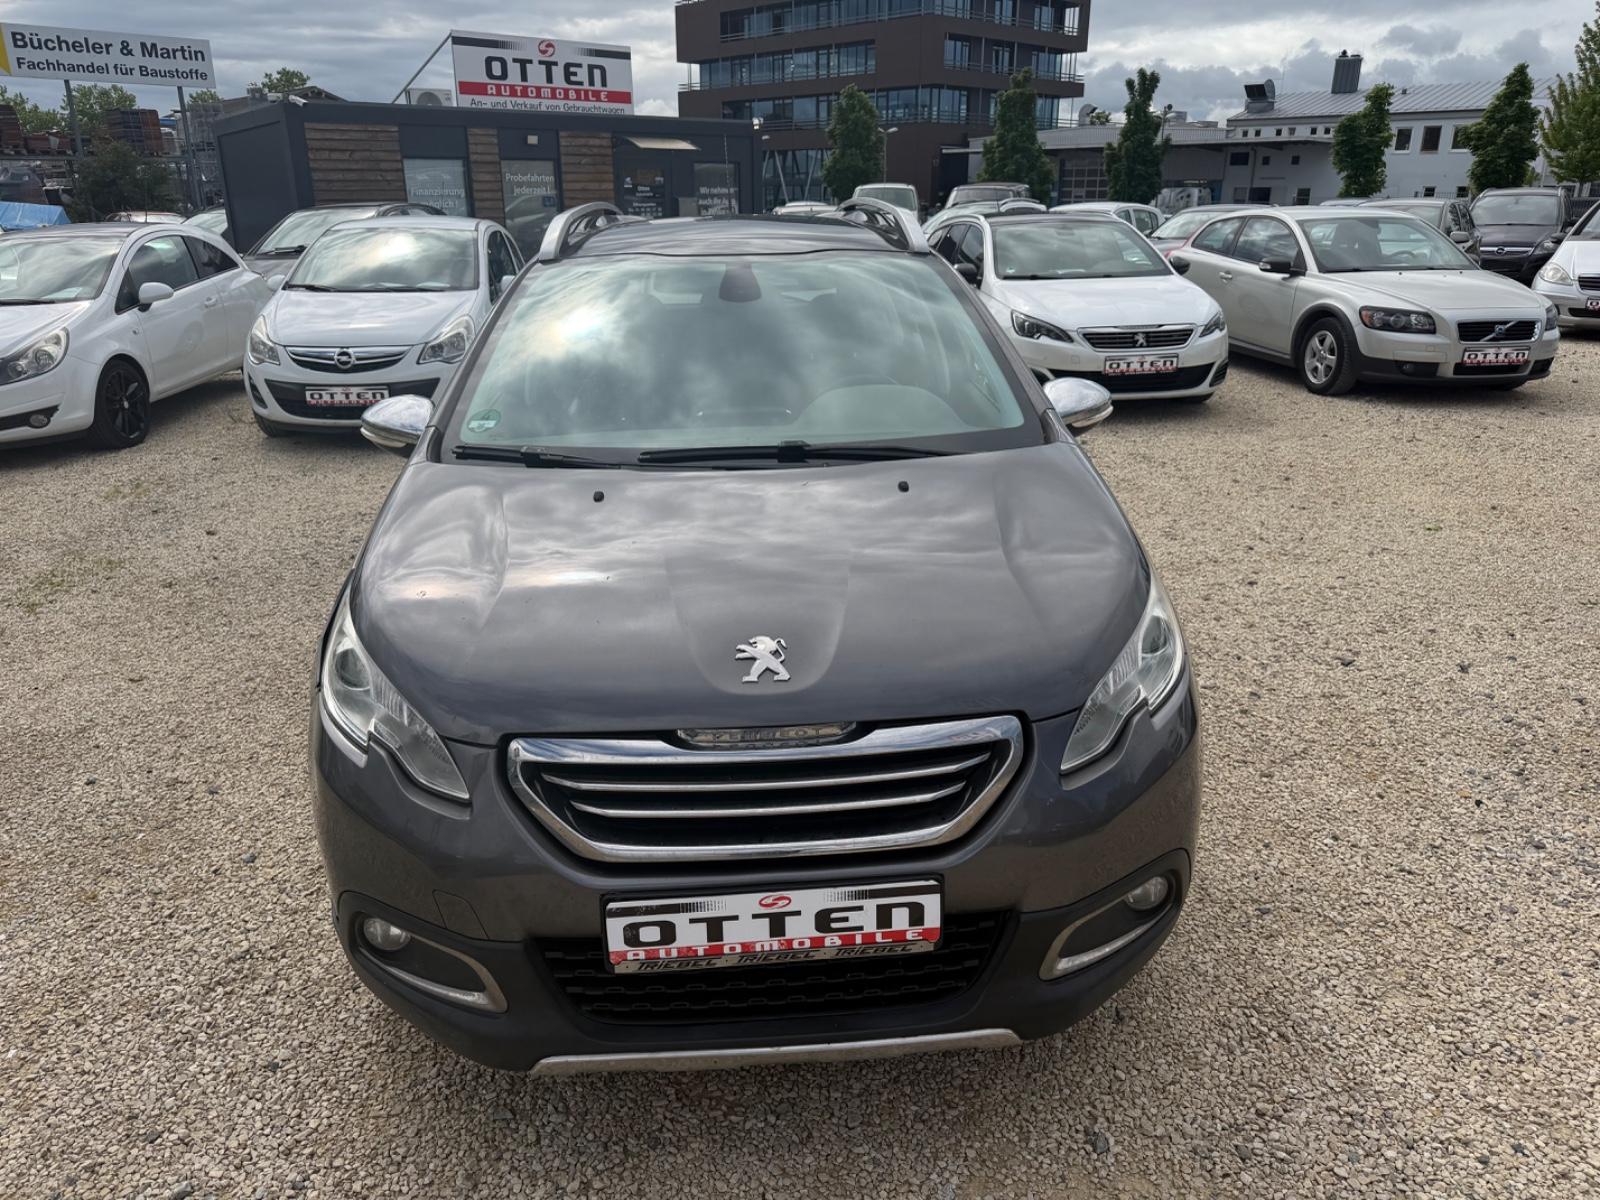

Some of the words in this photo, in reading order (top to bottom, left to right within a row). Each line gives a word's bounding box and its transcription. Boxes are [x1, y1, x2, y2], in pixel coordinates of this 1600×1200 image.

[11, 31, 113, 55] Bücheler
[119, 40, 135, 57] &
[140, 41, 206, 62] Martin
[16, 57, 110, 75] Fachhandel
[113, 63, 135, 76] für
[138, 65, 208, 81] Baustoffe
[484, 55, 608, 88] OTTEN
[487, 84, 609, 102] AUTOMOBILE
[470, 98, 488, 107] An-
[490, 99, 507, 108] und
[510, 101, 543, 110] Verkauf
[545, 103, 561, 111] von
[562, 102, 625, 114] Gebrauchtwagen
[505, 172, 555, 183] Probefahrten
[1109, 360, 1174, 369] OTTEN
[1467, 352, 1526, 360] OTTEN
[310, 392, 385, 400] OTTEN
[622, 901, 926, 948] OTTEN
[627, 929, 924, 961] AUTOMOBILE
[637, 957, 720, 971] TRIEBEL
